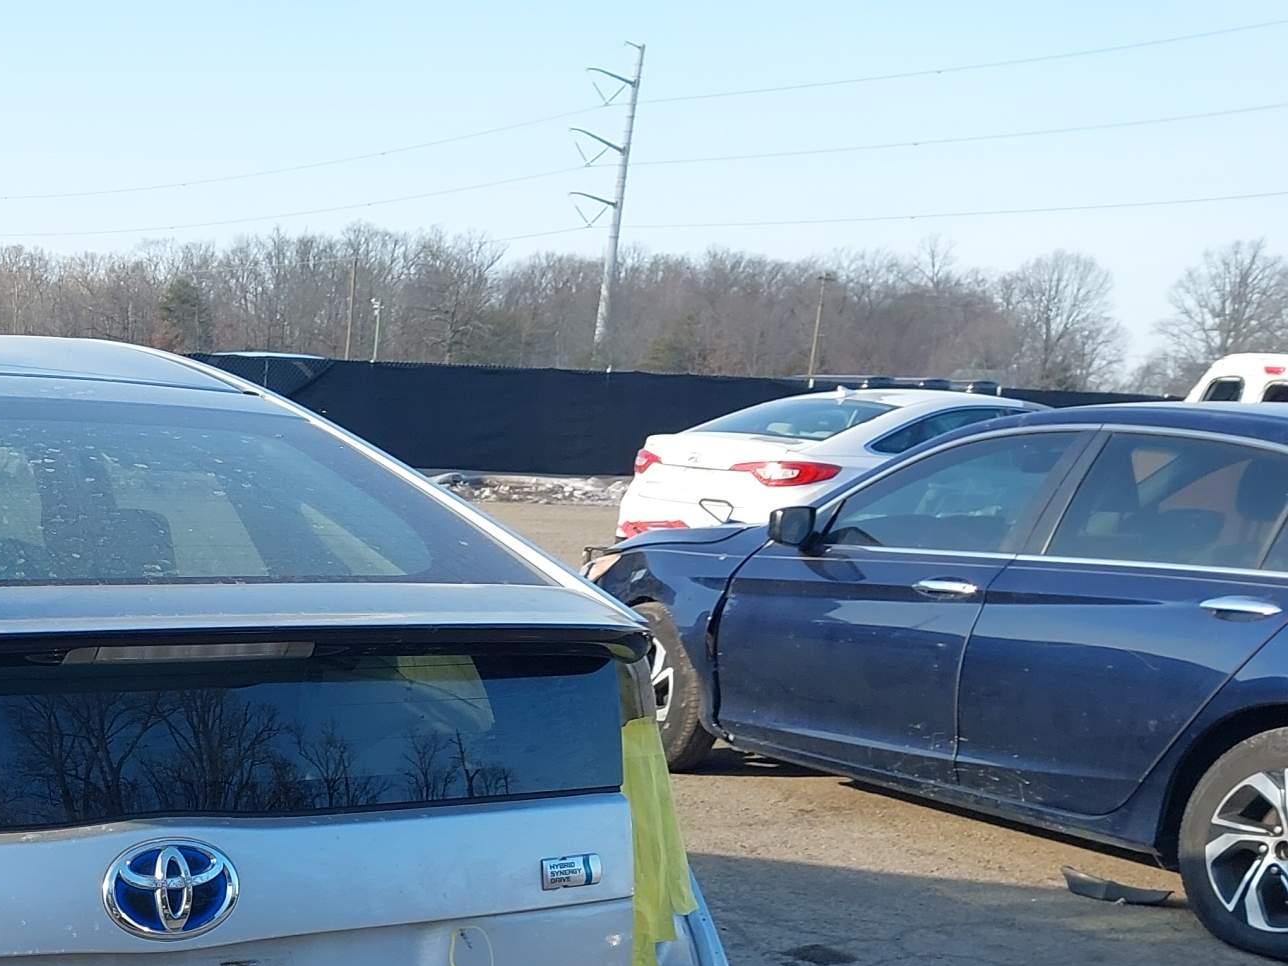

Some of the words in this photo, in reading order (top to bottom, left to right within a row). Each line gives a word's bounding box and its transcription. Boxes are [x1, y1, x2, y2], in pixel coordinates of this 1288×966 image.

[549, 861, 576, 870] HYBRID
[550, 867, 582, 877] SYNERGY
[550, 876, 571, 884] DRIVE
